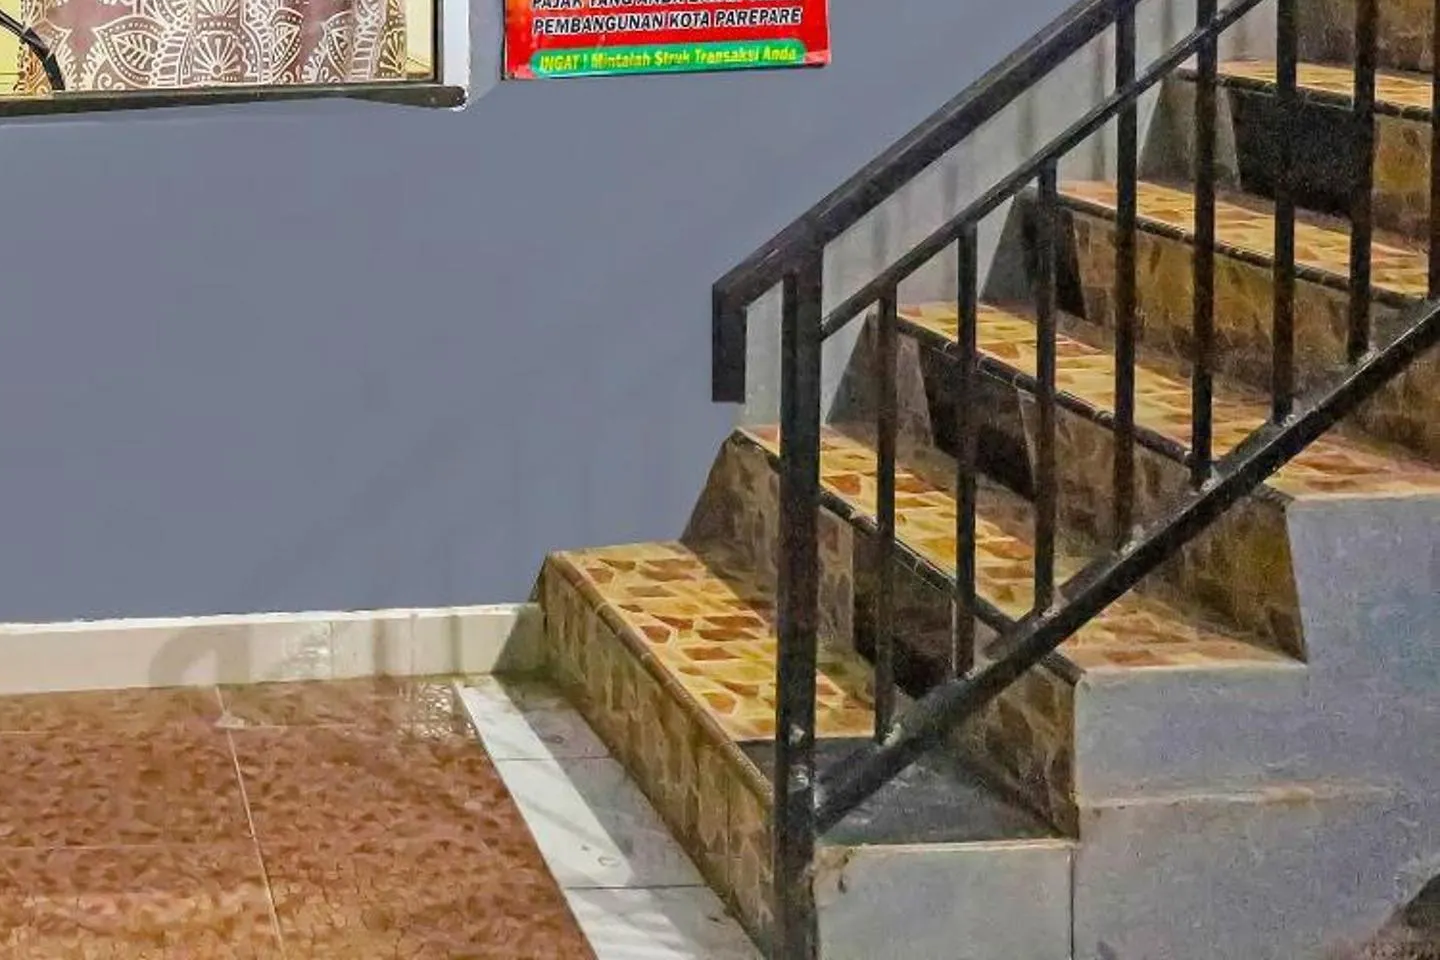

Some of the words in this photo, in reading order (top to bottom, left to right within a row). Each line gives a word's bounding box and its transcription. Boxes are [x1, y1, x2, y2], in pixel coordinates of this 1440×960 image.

[532, 12, 664, 35] PEMBANGUNAN
[668, 10, 710, 28] KOTA
[714, 6, 802, 26] PAREPARE
[539, 53, 581, 72] INGAT
[590, 50, 651, 69] Mintalah
[654, 48, 691, 66] Struk
[694, 45, 759, 64] Transaksi
[762, 44, 797, 61] Anda
